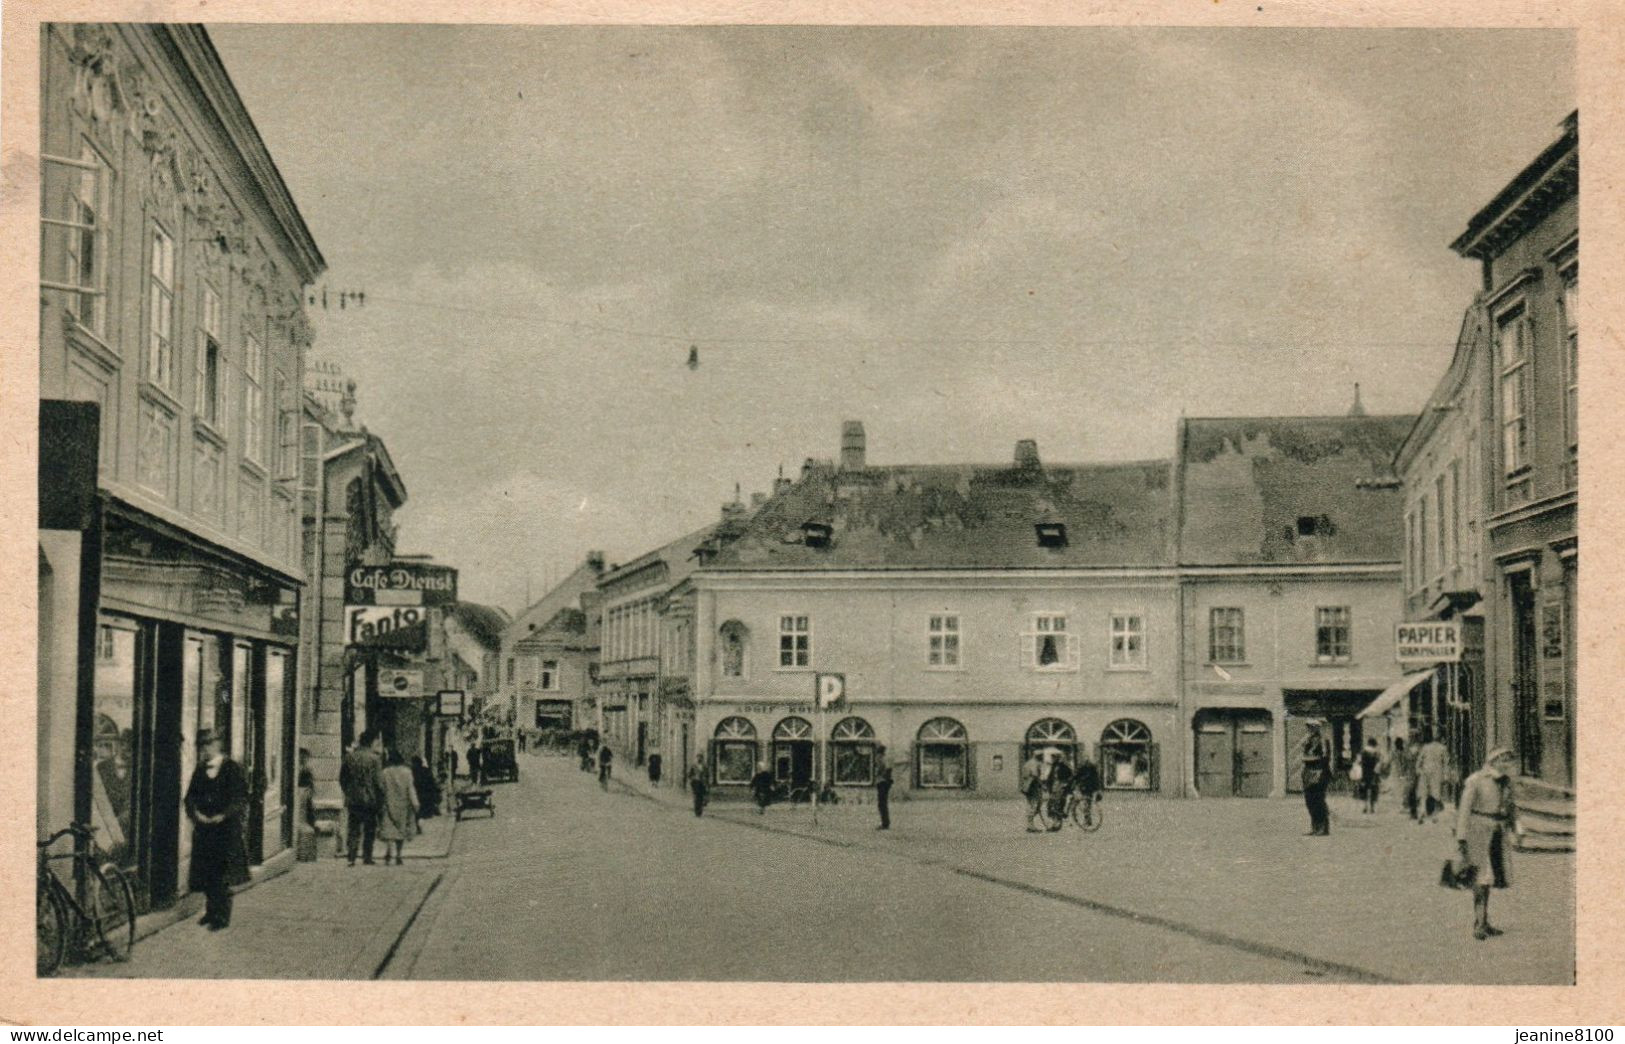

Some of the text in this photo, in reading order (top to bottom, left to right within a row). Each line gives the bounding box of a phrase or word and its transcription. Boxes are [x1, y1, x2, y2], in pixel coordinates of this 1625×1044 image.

[351, 569, 454, 591] Cafe Dienst
[351, 608, 418, 644] Fanto
[1398, 627, 1456, 644] PAPIER
[820, 675, 842, 707] P
